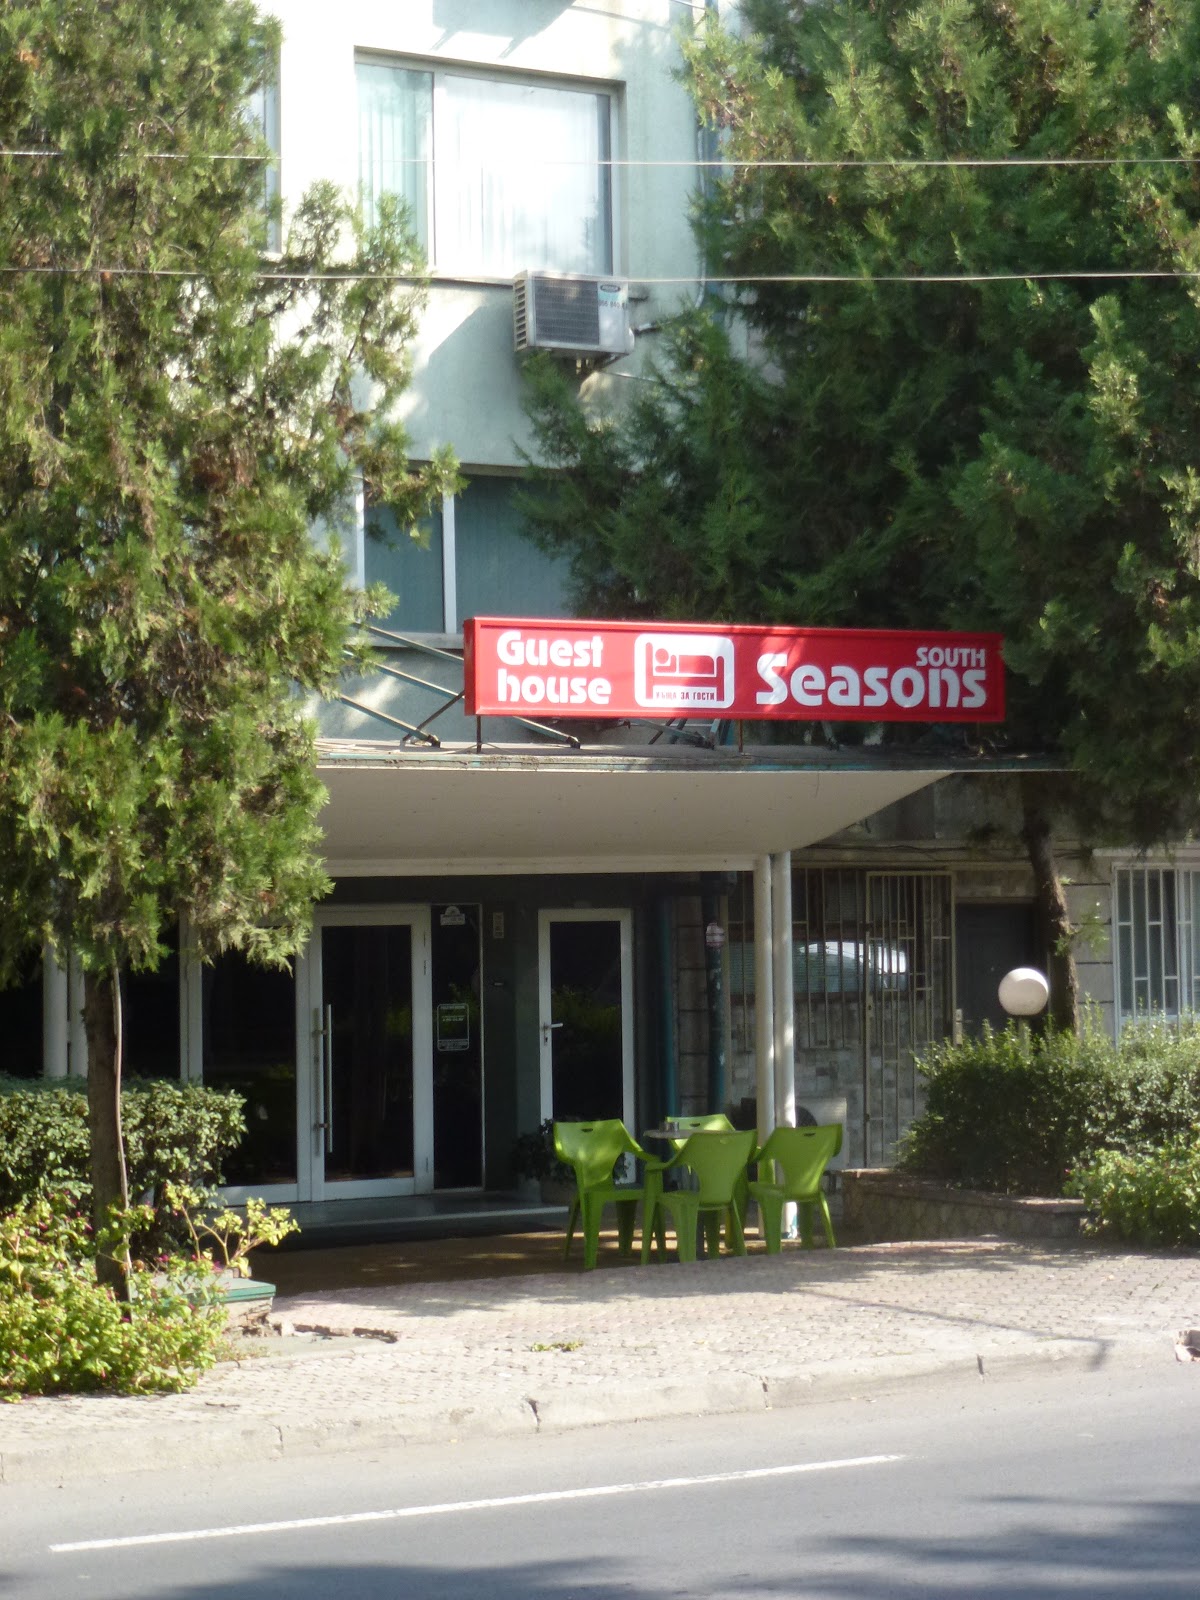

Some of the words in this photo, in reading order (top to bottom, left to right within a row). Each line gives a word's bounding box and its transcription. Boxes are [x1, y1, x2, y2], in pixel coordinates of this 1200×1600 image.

[497, 630, 604, 667] Guest
[915, 647, 987, 668] SOUTH
[497, 668, 612, 705] house
[680, 692, 690, 700] ЗА
[693, 692, 715, 701] ГОСТИ
[756, 653, 988, 708] Seasons
